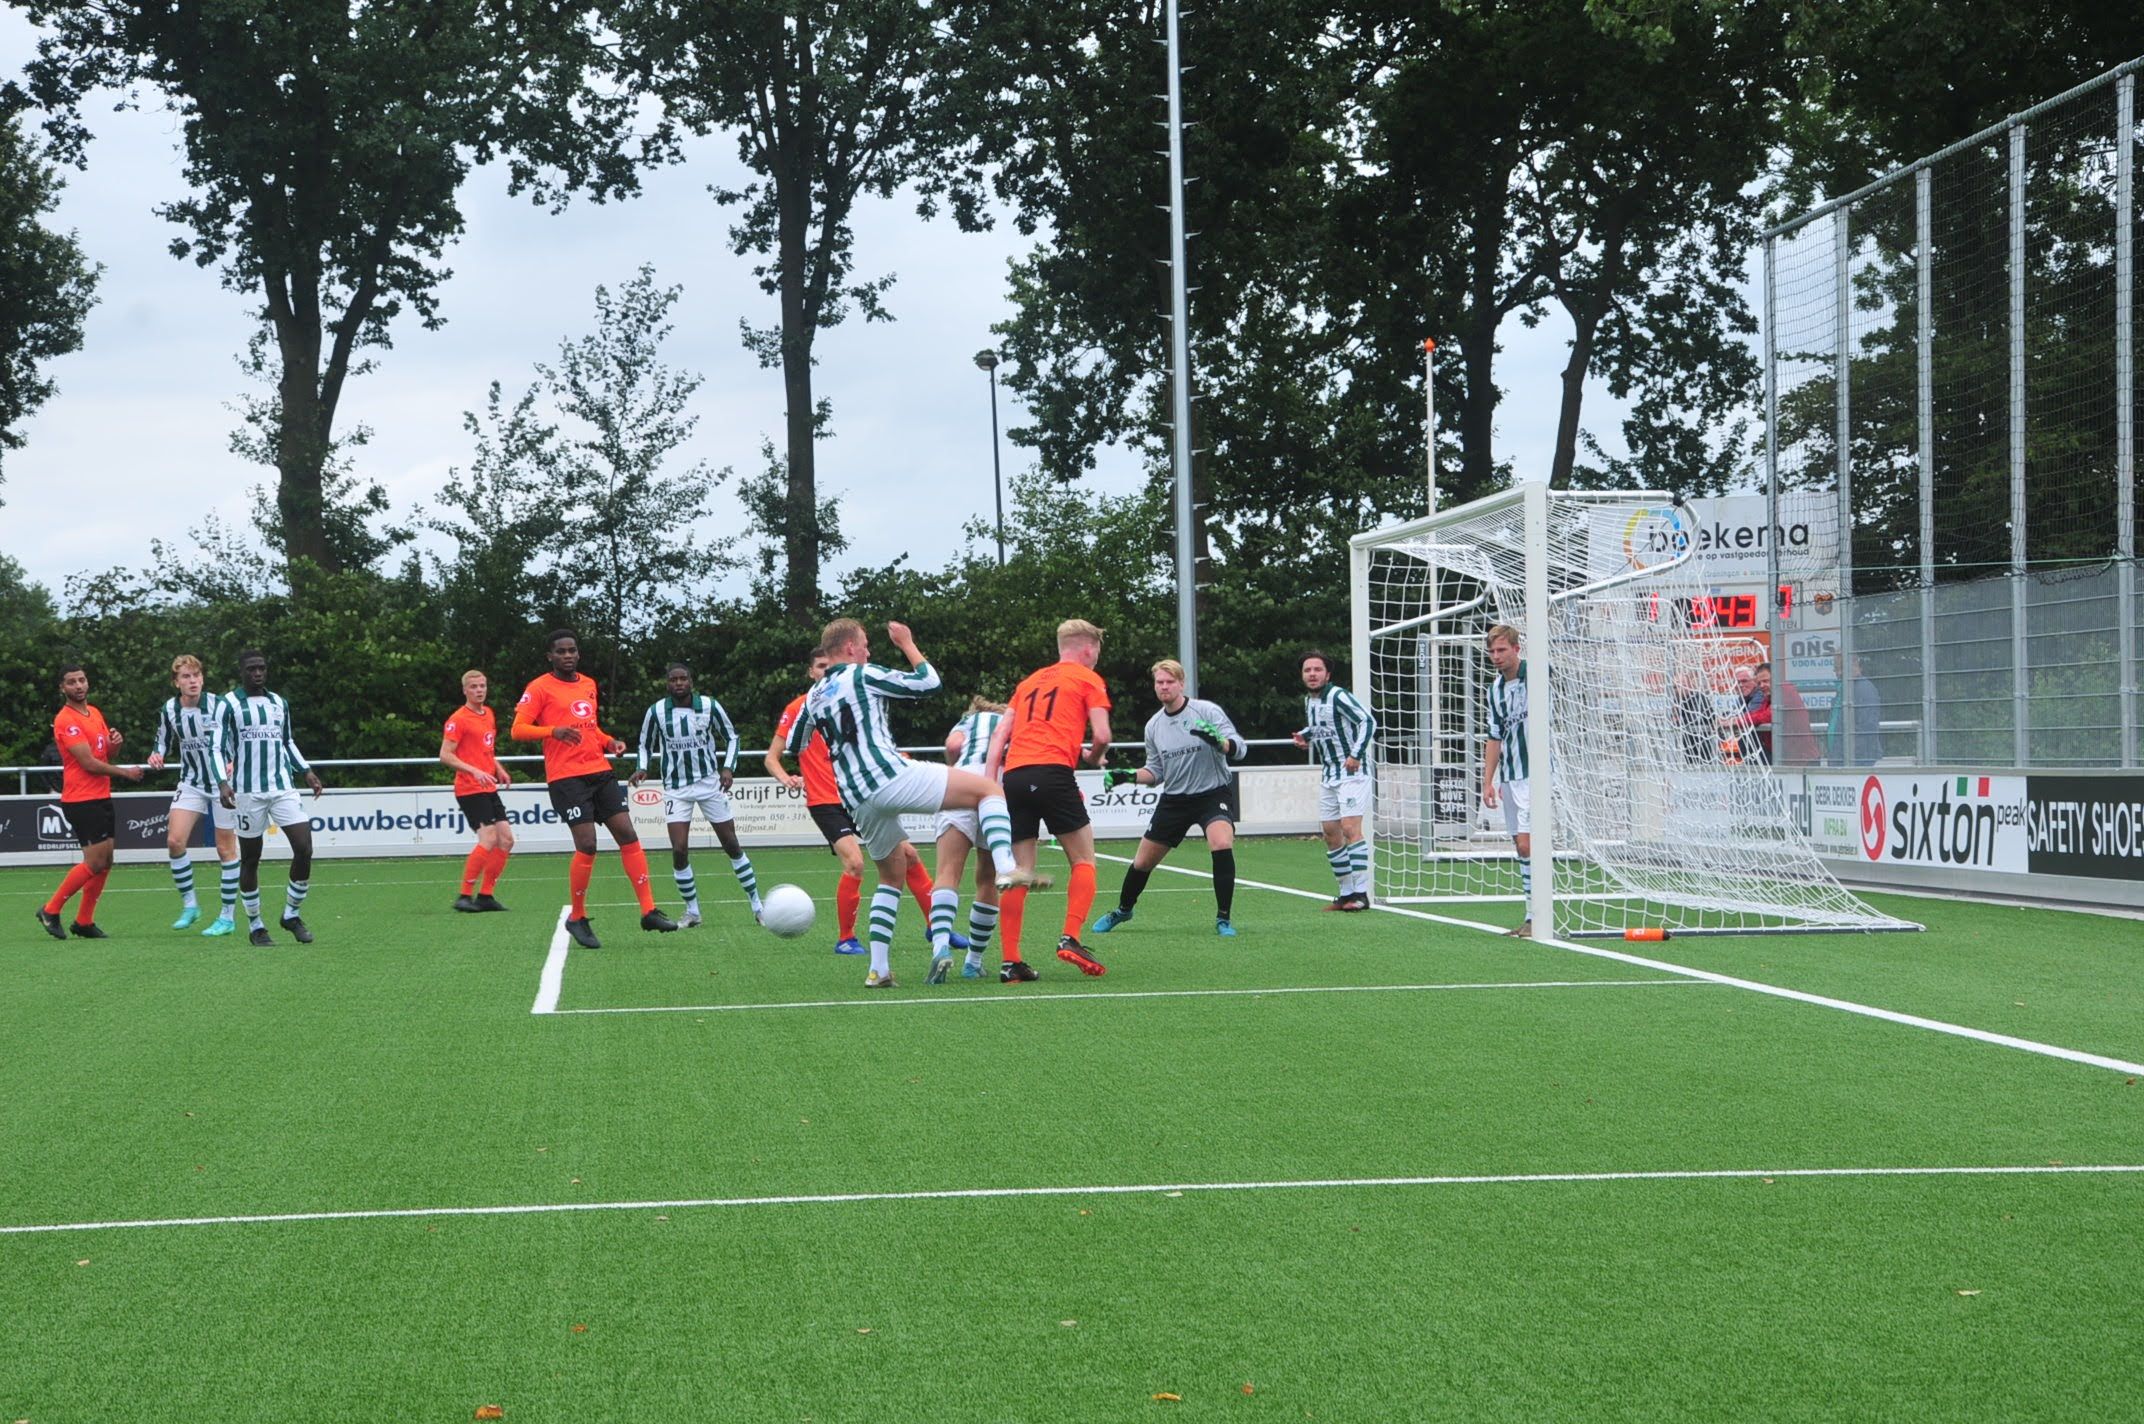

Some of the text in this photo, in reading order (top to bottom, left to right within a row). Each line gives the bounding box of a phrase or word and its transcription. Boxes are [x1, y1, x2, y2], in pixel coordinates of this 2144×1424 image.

[1720, 547, 1809, 560] vastgoedoerhoud
[1791, 641, 1836, 657] ONS
[1023, 686, 1059, 723] 11
[636, 793, 659, 803] KIA
[727, 786, 808, 804] edrijf PO
[1090, 789, 1158, 806] sixto
[309, 803, 566, 834] ouwbedrij ade
[566, 806, 582, 820] 20
[634, 815, 666, 825] Paradijs
[733, 816, 766, 825] oningen
[770, 813, 785, 821] 050
[1138, 808, 1154, 817] pe
[237, 814, 250, 831] 15
[1891, 780, 2027, 866] sixton peak
[2027, 800, 2144, 858] SAFETY SHOE
